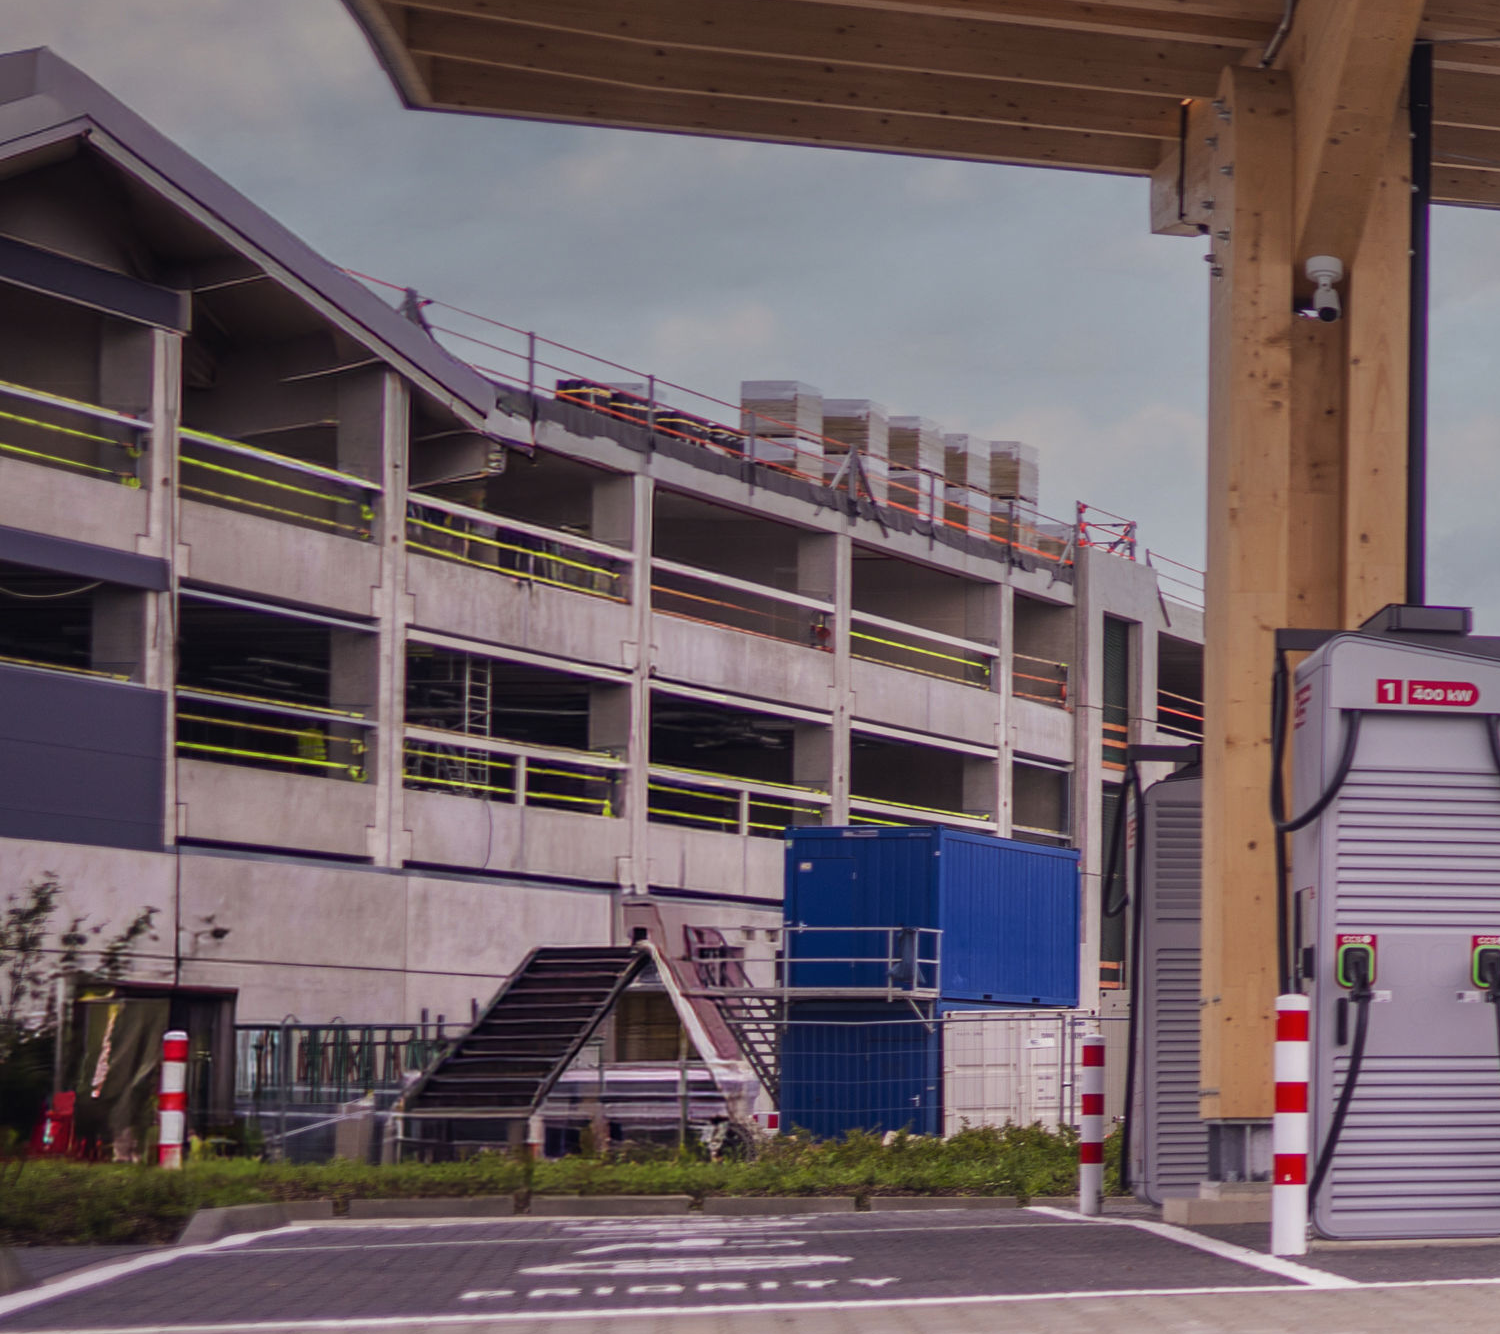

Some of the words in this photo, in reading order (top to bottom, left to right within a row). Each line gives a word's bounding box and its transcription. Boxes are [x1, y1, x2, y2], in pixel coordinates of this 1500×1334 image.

[1382, 682, 1395, 701] 1
[1412, 687, 1445, 701] 400
[459, 1276, 901, 1301] PRIORITY
